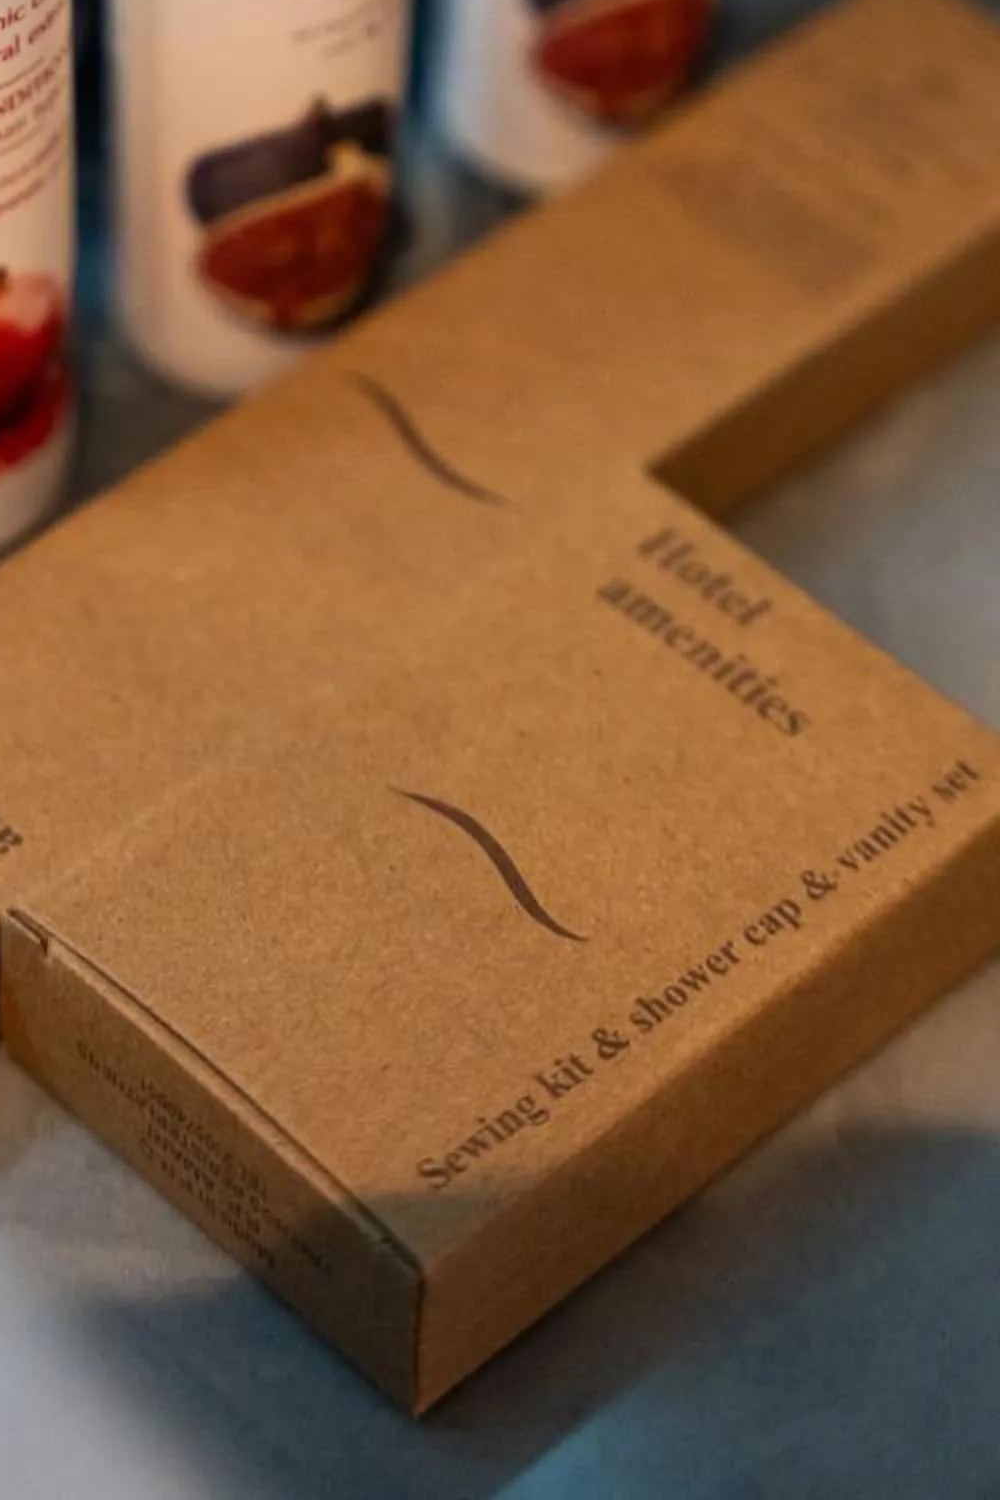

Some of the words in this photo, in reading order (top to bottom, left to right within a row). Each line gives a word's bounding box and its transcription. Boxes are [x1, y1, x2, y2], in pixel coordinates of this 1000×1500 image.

[595, 577, 811, 738] amenities
[637, 526, 774, 629] Hotel
[416, 1094, 550, 1191] Sewing
[533, 1052, 595, 1100] kit
[590, 1026, 630, 1062] &
[629, 940, 741, 1035] shower
[743, 898, 803, 947] cap
[801, 868, 839, 902] &
[835, 794, 937, 874] vanity
[931, 758, 981, 803] set
